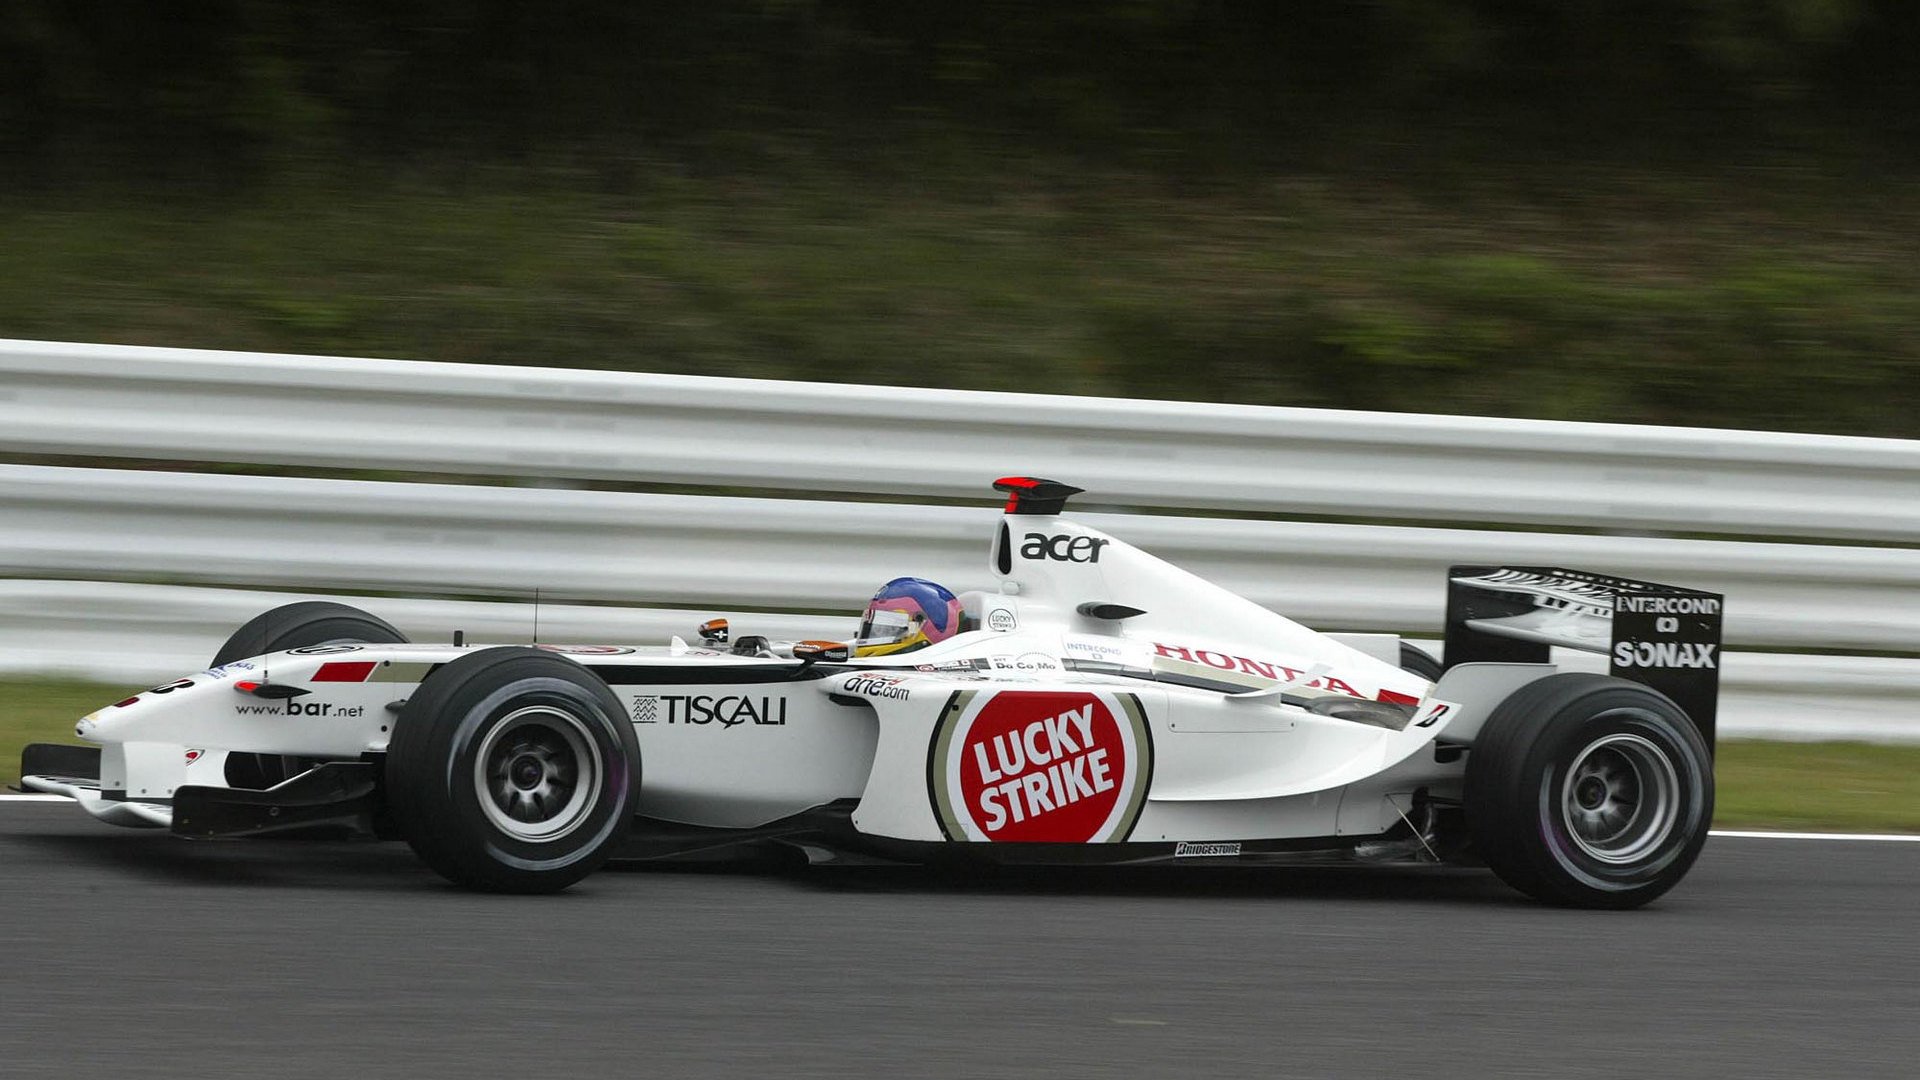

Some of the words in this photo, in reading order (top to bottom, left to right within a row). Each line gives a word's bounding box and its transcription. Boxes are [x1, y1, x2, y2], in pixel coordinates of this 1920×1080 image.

[1020, 532, 1110, 563] acer
[1615, 596, 1720, 615] INTERCOND
[1613, 641, 1717, 669] SONAX
[844, 677, 910, 701] one.com
[236, 697, 364, 717] www.bar.net
[660, 695, 786, 730] TISCALI
[973, 703, 1095, 785] LUCKY
[979, 748, 1114, 831] STRIKE
[1176, 842, 1240, 855] BRIDGESTONE
